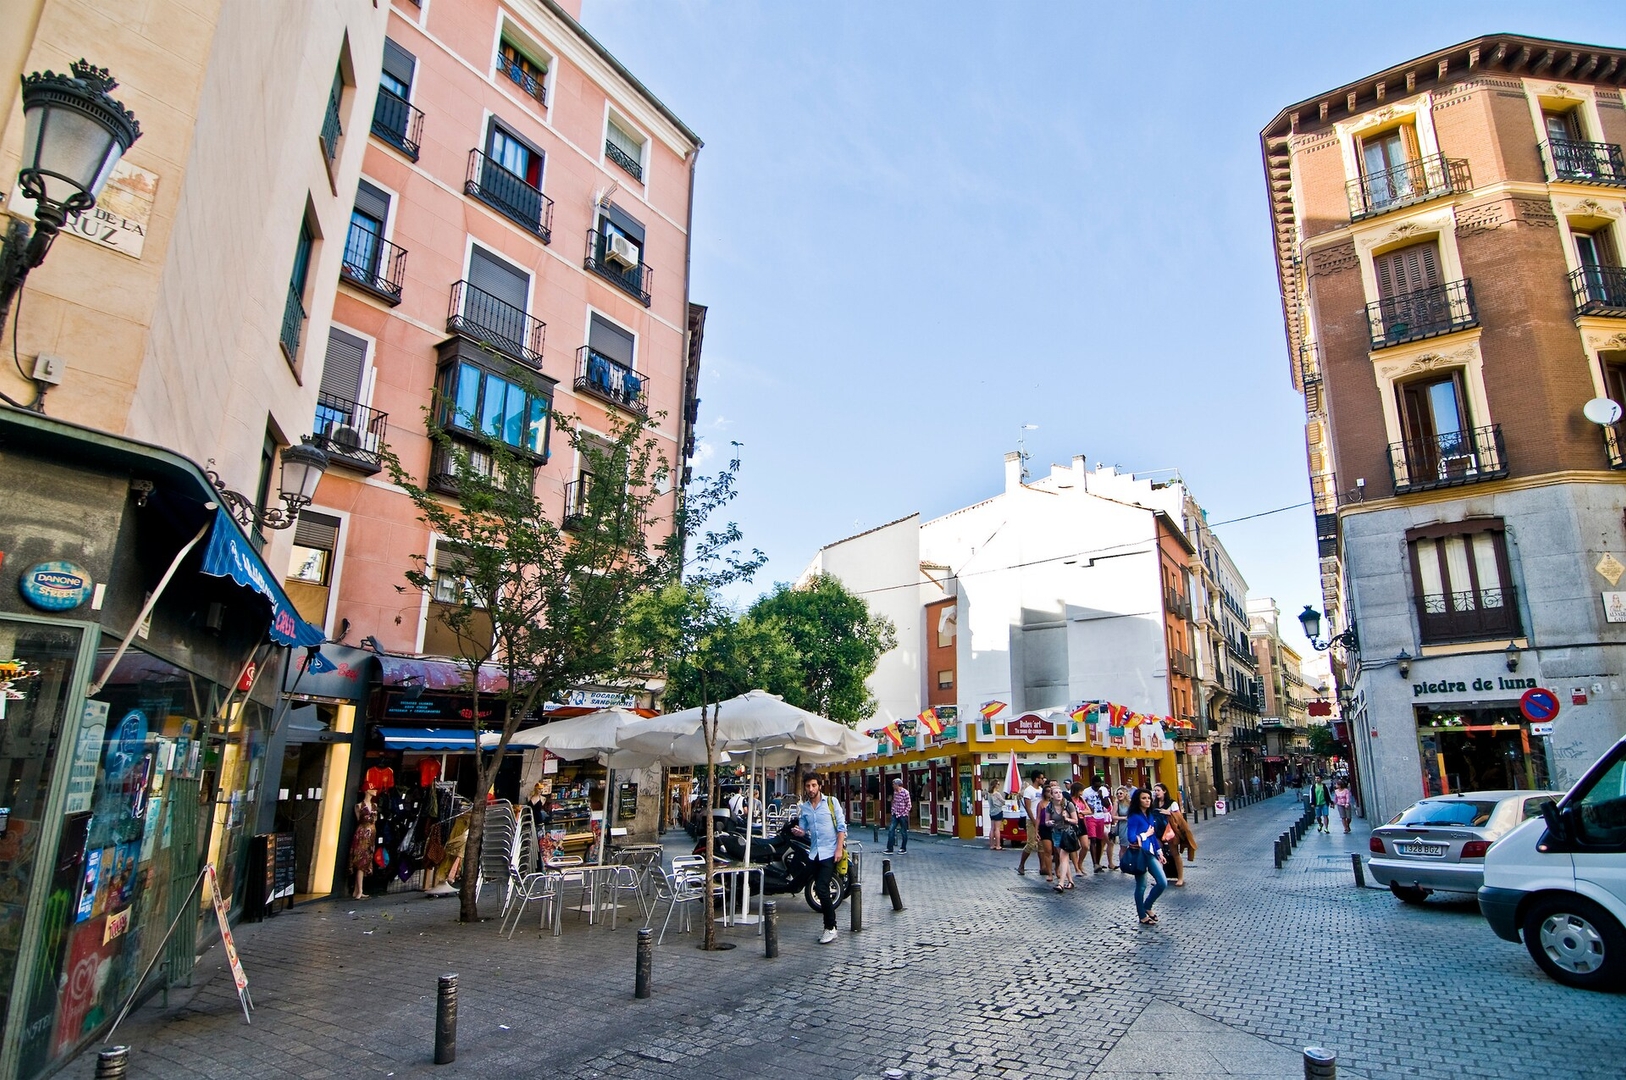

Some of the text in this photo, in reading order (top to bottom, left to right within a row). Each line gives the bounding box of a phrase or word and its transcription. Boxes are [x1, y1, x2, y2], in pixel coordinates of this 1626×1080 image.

[65, 213, 118, 246] RUZ
[93, 207, 144, 237] DE LA
[1412, 676, 1537, 697] piedra de luna
